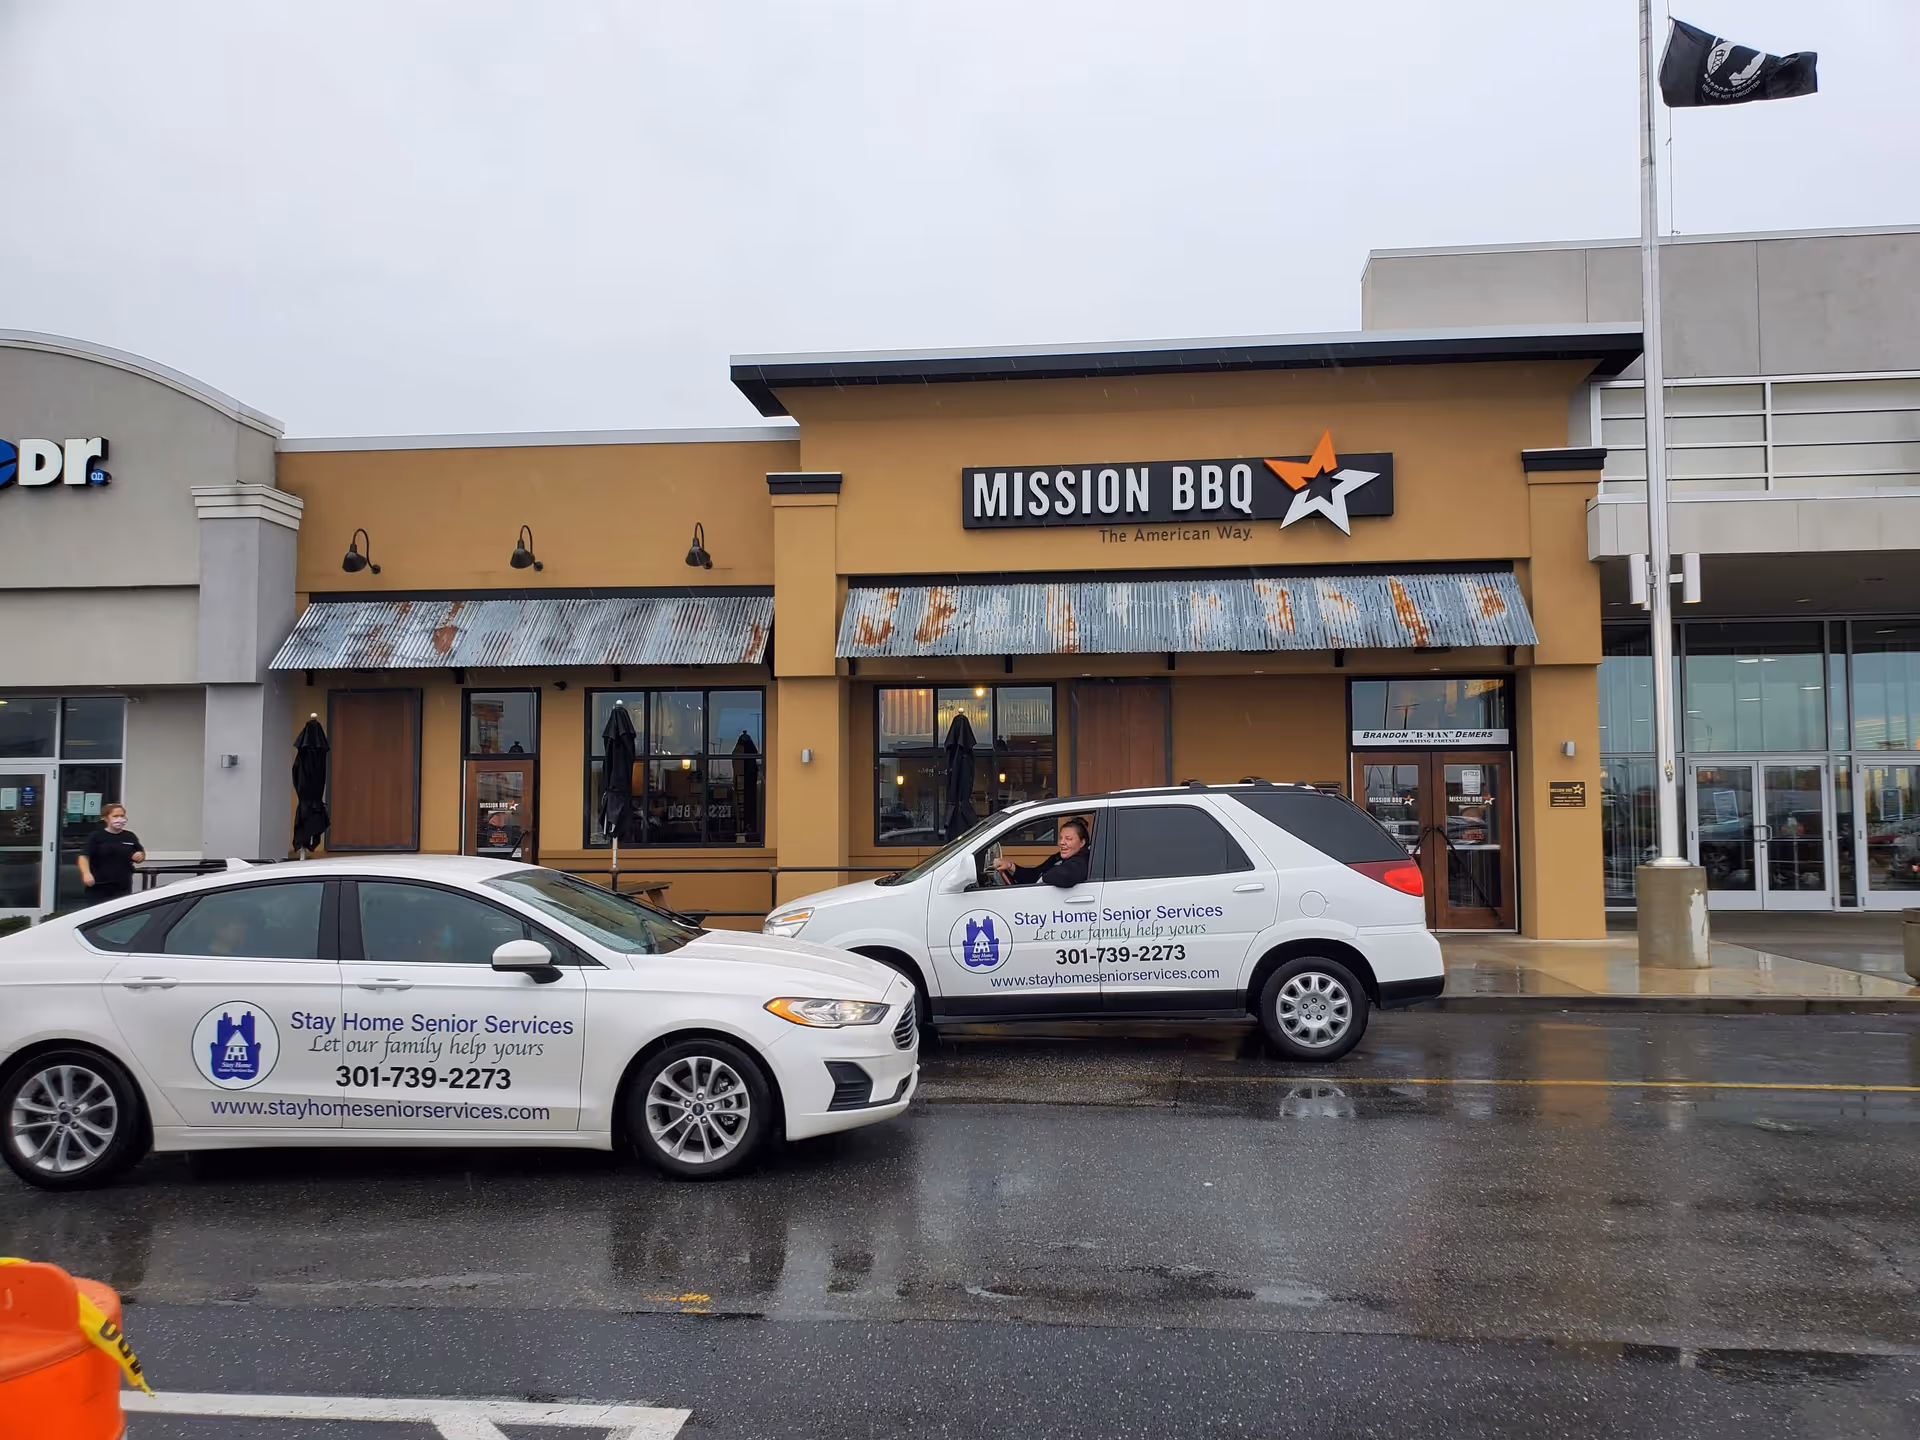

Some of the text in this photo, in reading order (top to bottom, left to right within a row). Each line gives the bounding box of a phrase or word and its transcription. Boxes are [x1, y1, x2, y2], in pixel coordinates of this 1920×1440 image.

[973, 464, 1253, 518] MISSION BBQ
[1099, 525, 1253, 543] The American Way.
[1362, 731, 1408, 739] BRANDON
[1455, 730, 1494, 738] DEMERS
[1014, 903, 1223, 928] Stay Home Senior Services
[1033, 919, 1206, 945] Let our family help yours
[1055, 944, 1186, 965] 301-739-2273
[991, 968, 1220, 987] www.stayhomeseniorservices.com
[290, 1011, 574, 1035] Stay Home Senior Services
[308, 1031, 544, 1064] Let our family help yours
[335, 1065, 511, 1090] 301-739-2273
[211, 1099, 550, 1120] www.stayhomeseniorservices.com
